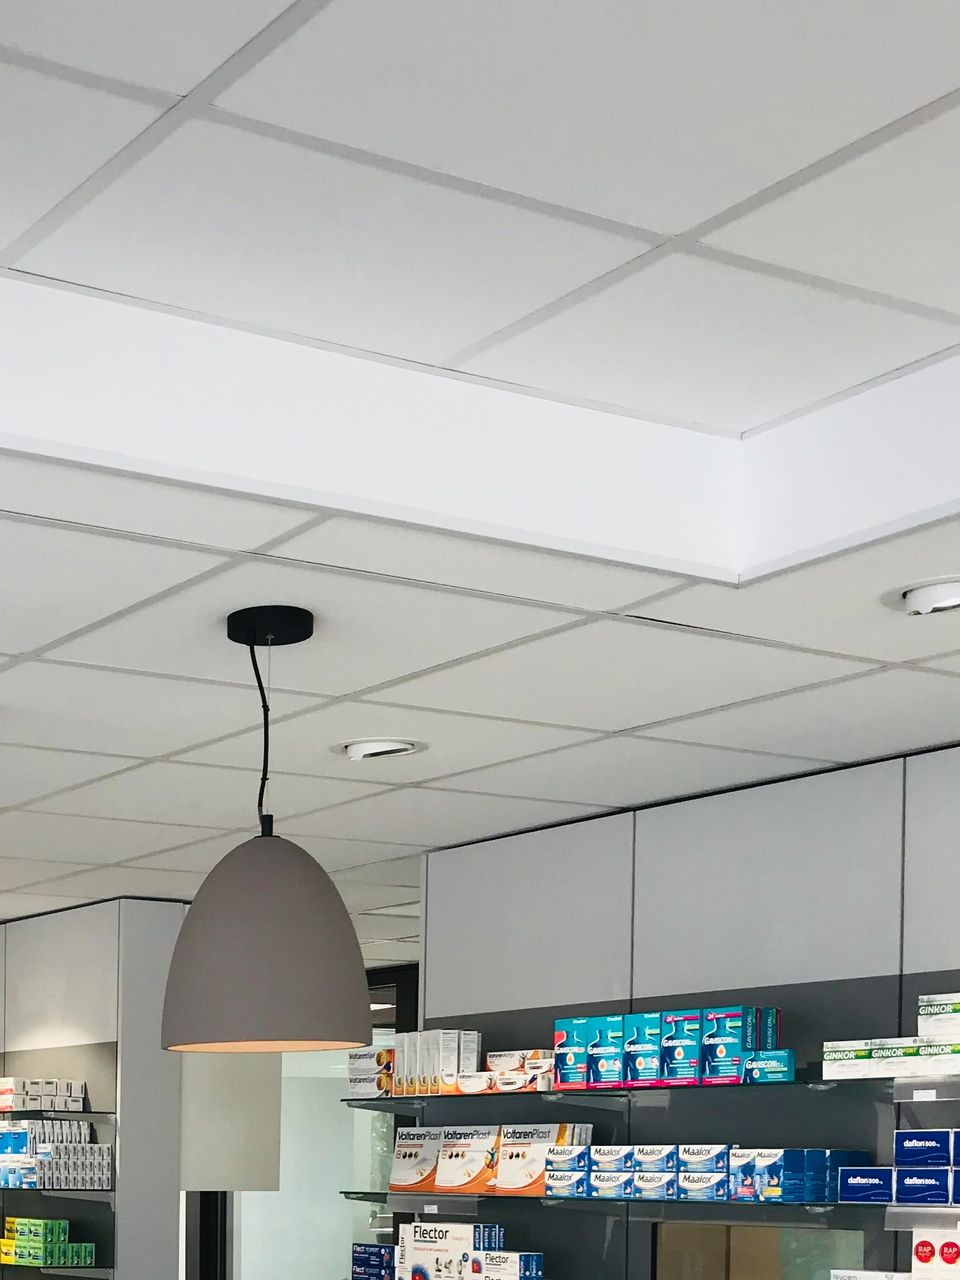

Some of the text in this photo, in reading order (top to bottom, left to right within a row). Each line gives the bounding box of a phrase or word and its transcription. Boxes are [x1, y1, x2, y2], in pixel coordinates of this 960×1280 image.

[919, 1004, 953, 1015] GINKOR
[872, 1048, 904, 1058] GINKOR
[919, 1045, 952, 1055] GINKOR
[824, 1051, 855, 1060] GINKOR
[502, 1128, 551, 1140] VoltarenPlast
[547, 1147, 573, 1156] Maalox
[593, 1147, 621, 1157] Maalox
[637, 1147, 663, 1156] Maalox
[682, 1146, 711, 1156] Maalox
[547, 1173, 573, 1183] Maalox
[593, 1174, 621, 1183] Maalox
[637, 1174, 663, 1183] Maalox
[682, 1173, 712, 1183] Maalox
[414, 1225, 449, 1240] Flector
[485, 1253, 510, 1263] Flector
